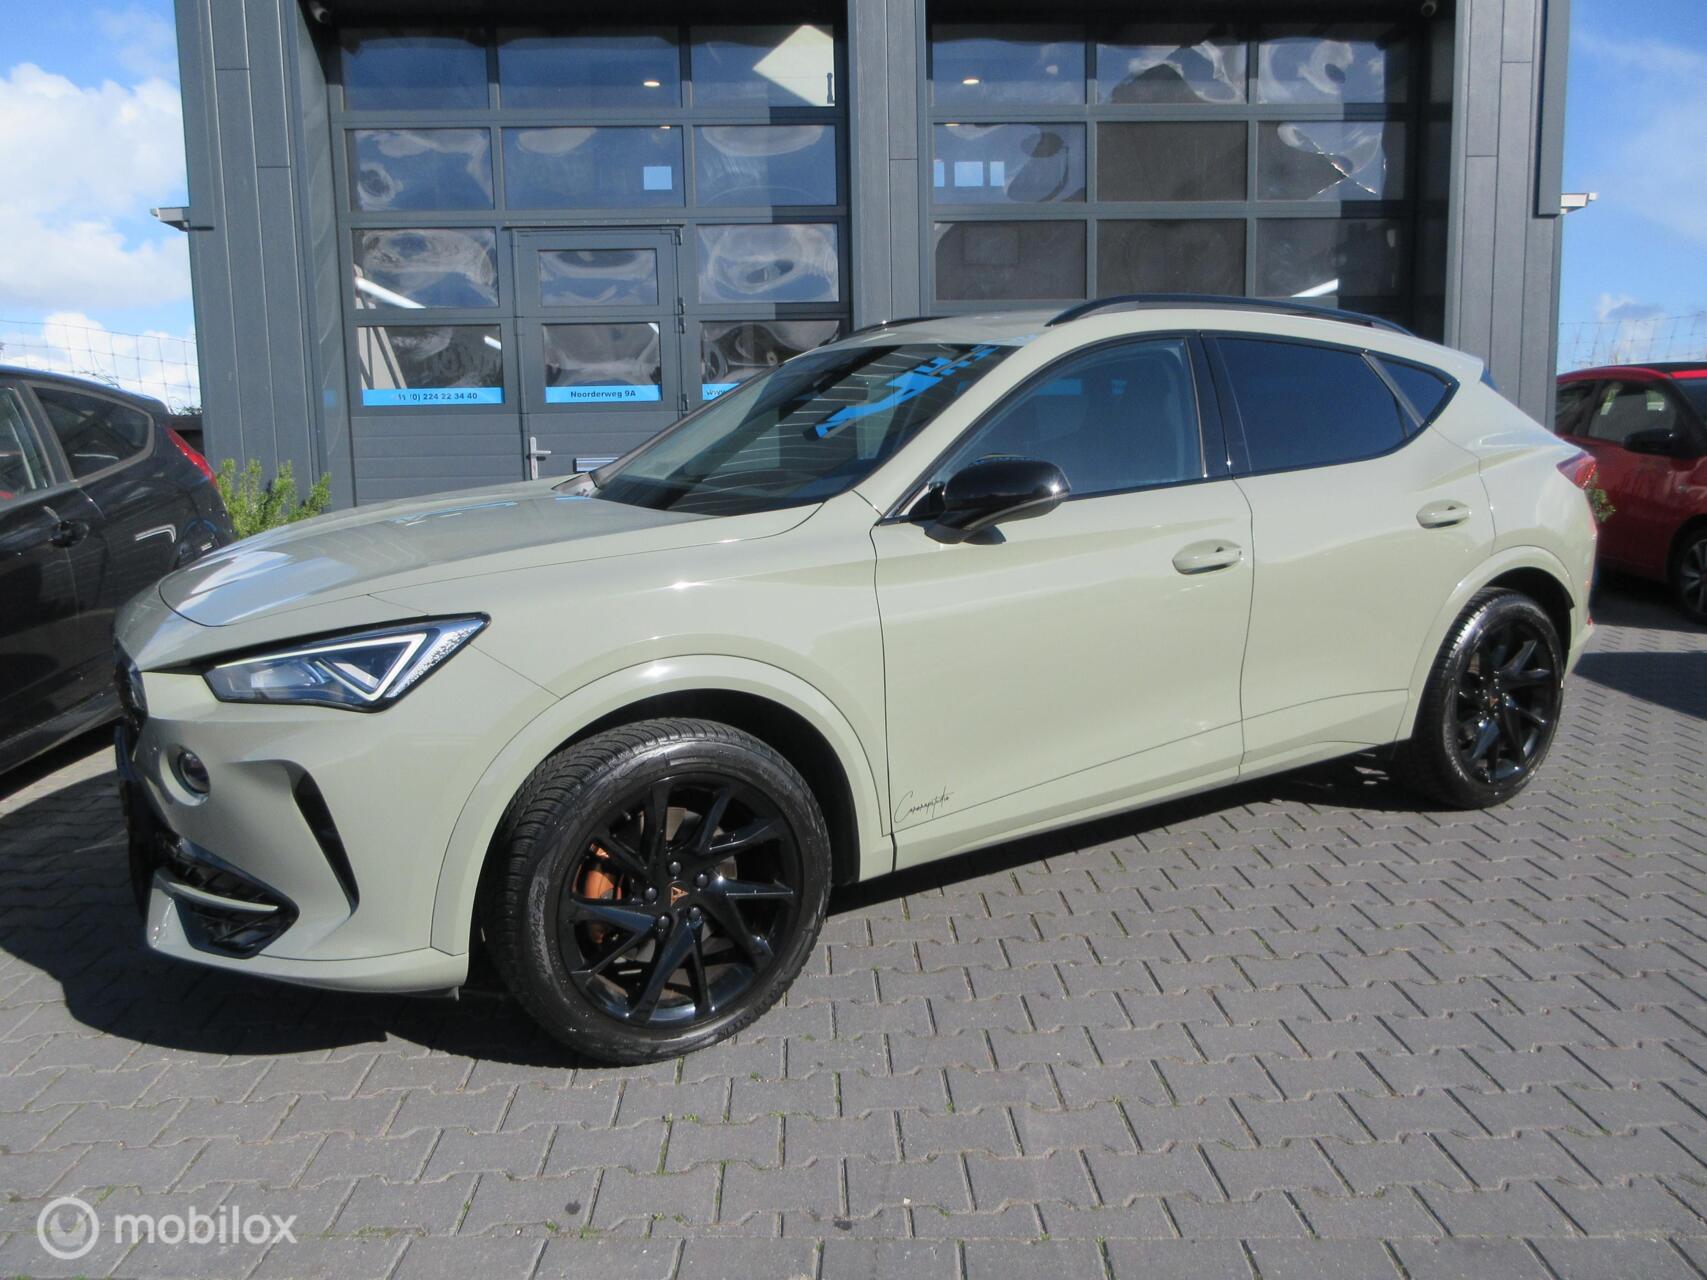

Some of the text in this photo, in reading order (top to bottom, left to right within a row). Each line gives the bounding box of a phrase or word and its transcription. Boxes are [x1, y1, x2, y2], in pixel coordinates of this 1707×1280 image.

[409, 392, 421, 402] (0)
[423, 392, 439, 400] 224
[441, 392, 452, 400] 22
[454, 392, 465, 400] 34
[467, 391, 478, 399] 40
[570, 390, 623, 398] Noorderweg
